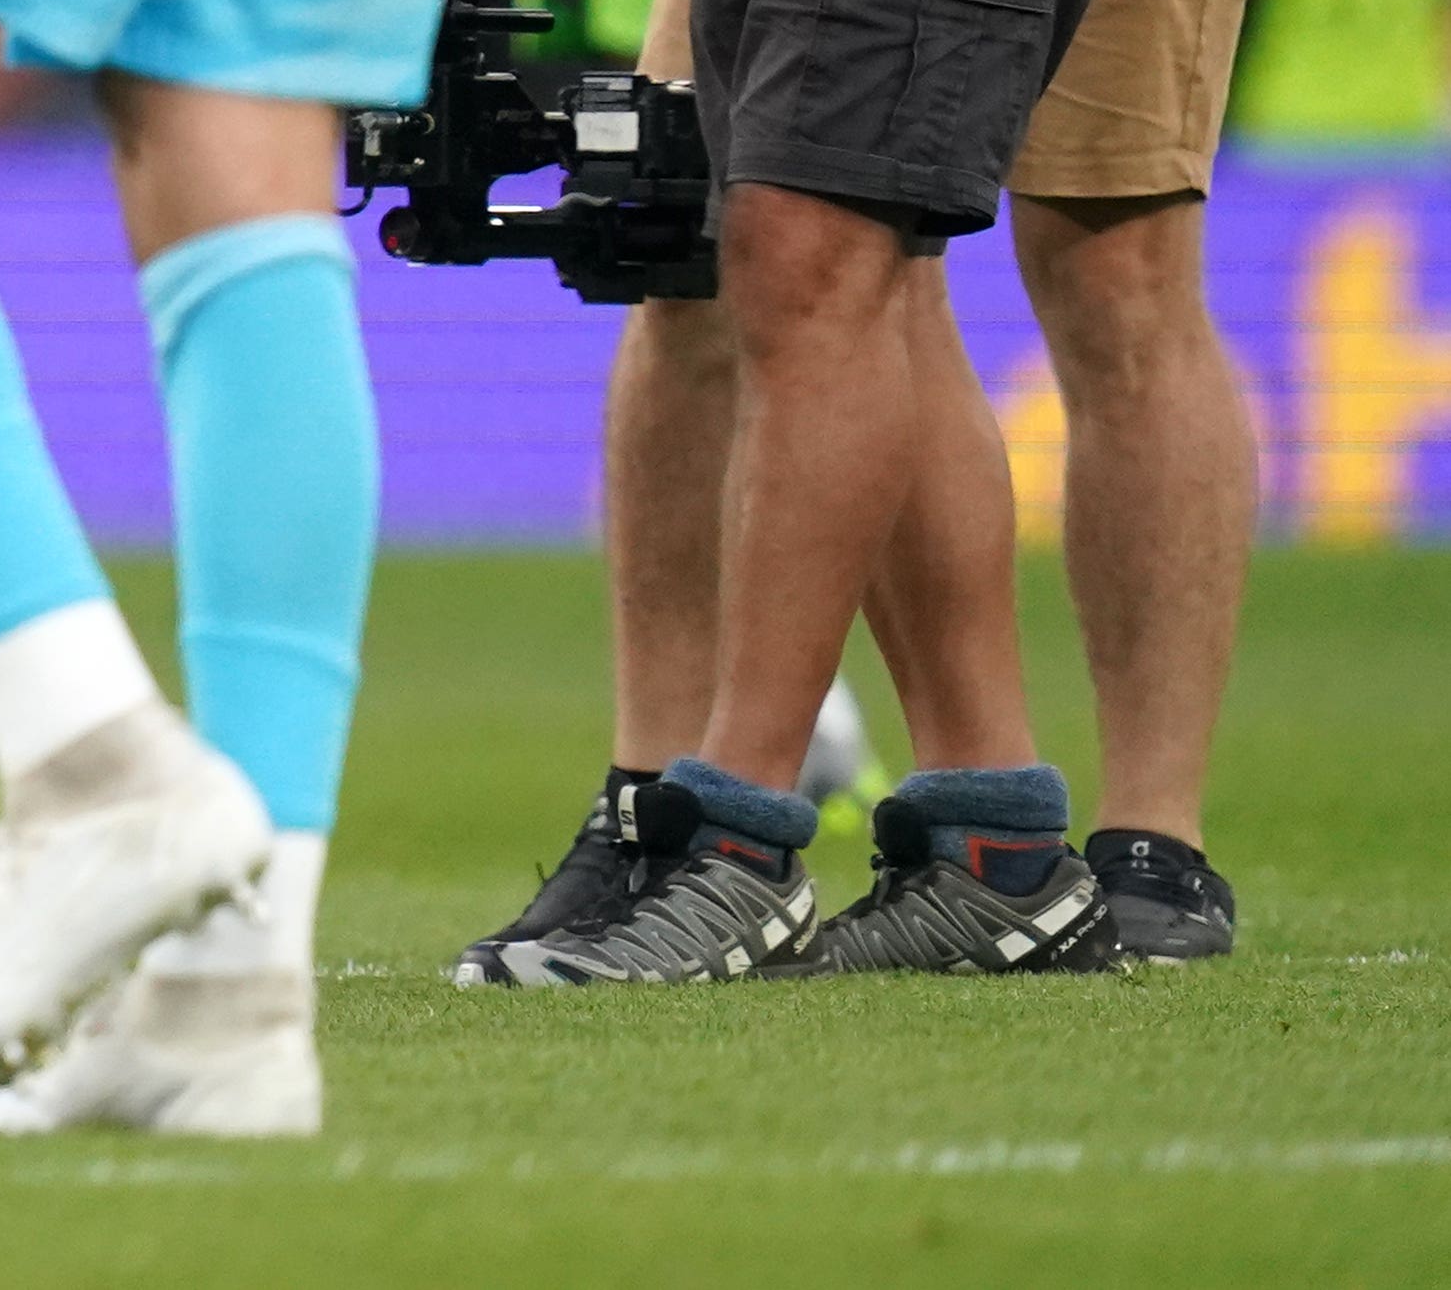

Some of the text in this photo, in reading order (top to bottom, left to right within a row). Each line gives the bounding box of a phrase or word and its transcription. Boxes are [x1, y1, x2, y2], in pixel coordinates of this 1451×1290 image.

[1058, 904, 1108, 954] XA Pro 3D
